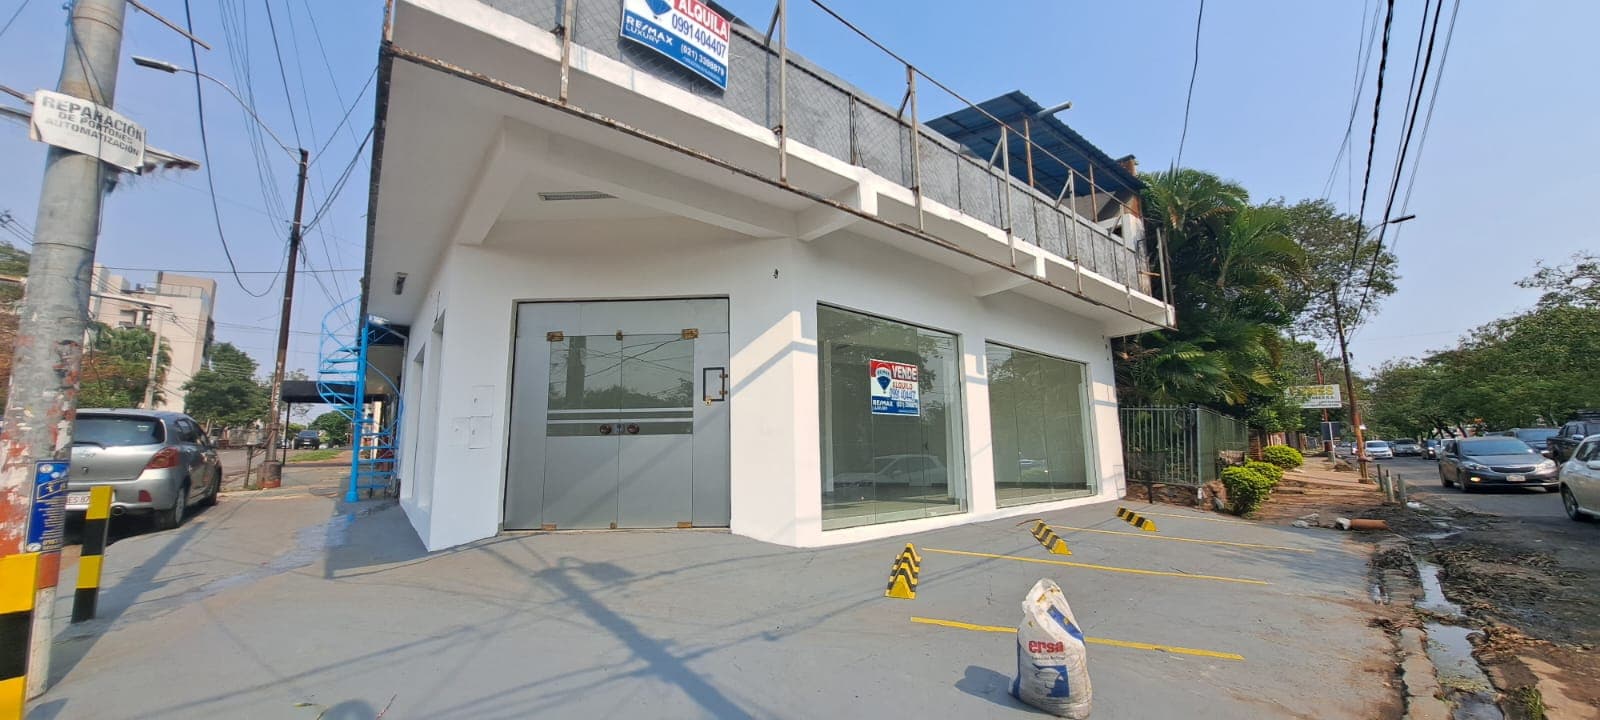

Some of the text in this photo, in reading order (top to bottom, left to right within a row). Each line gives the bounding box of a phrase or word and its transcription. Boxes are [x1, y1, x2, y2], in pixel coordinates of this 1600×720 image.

[678, 0, 728, 38] ALQUILA
[625, 24, 660, 44] LUXURY
[626, 15, 673, 45] RE/MAX
[58, 111, 75, 121] DE
[891, 364, 918, 381] VENDE
[1028, 640, 1064, 653] ersa
